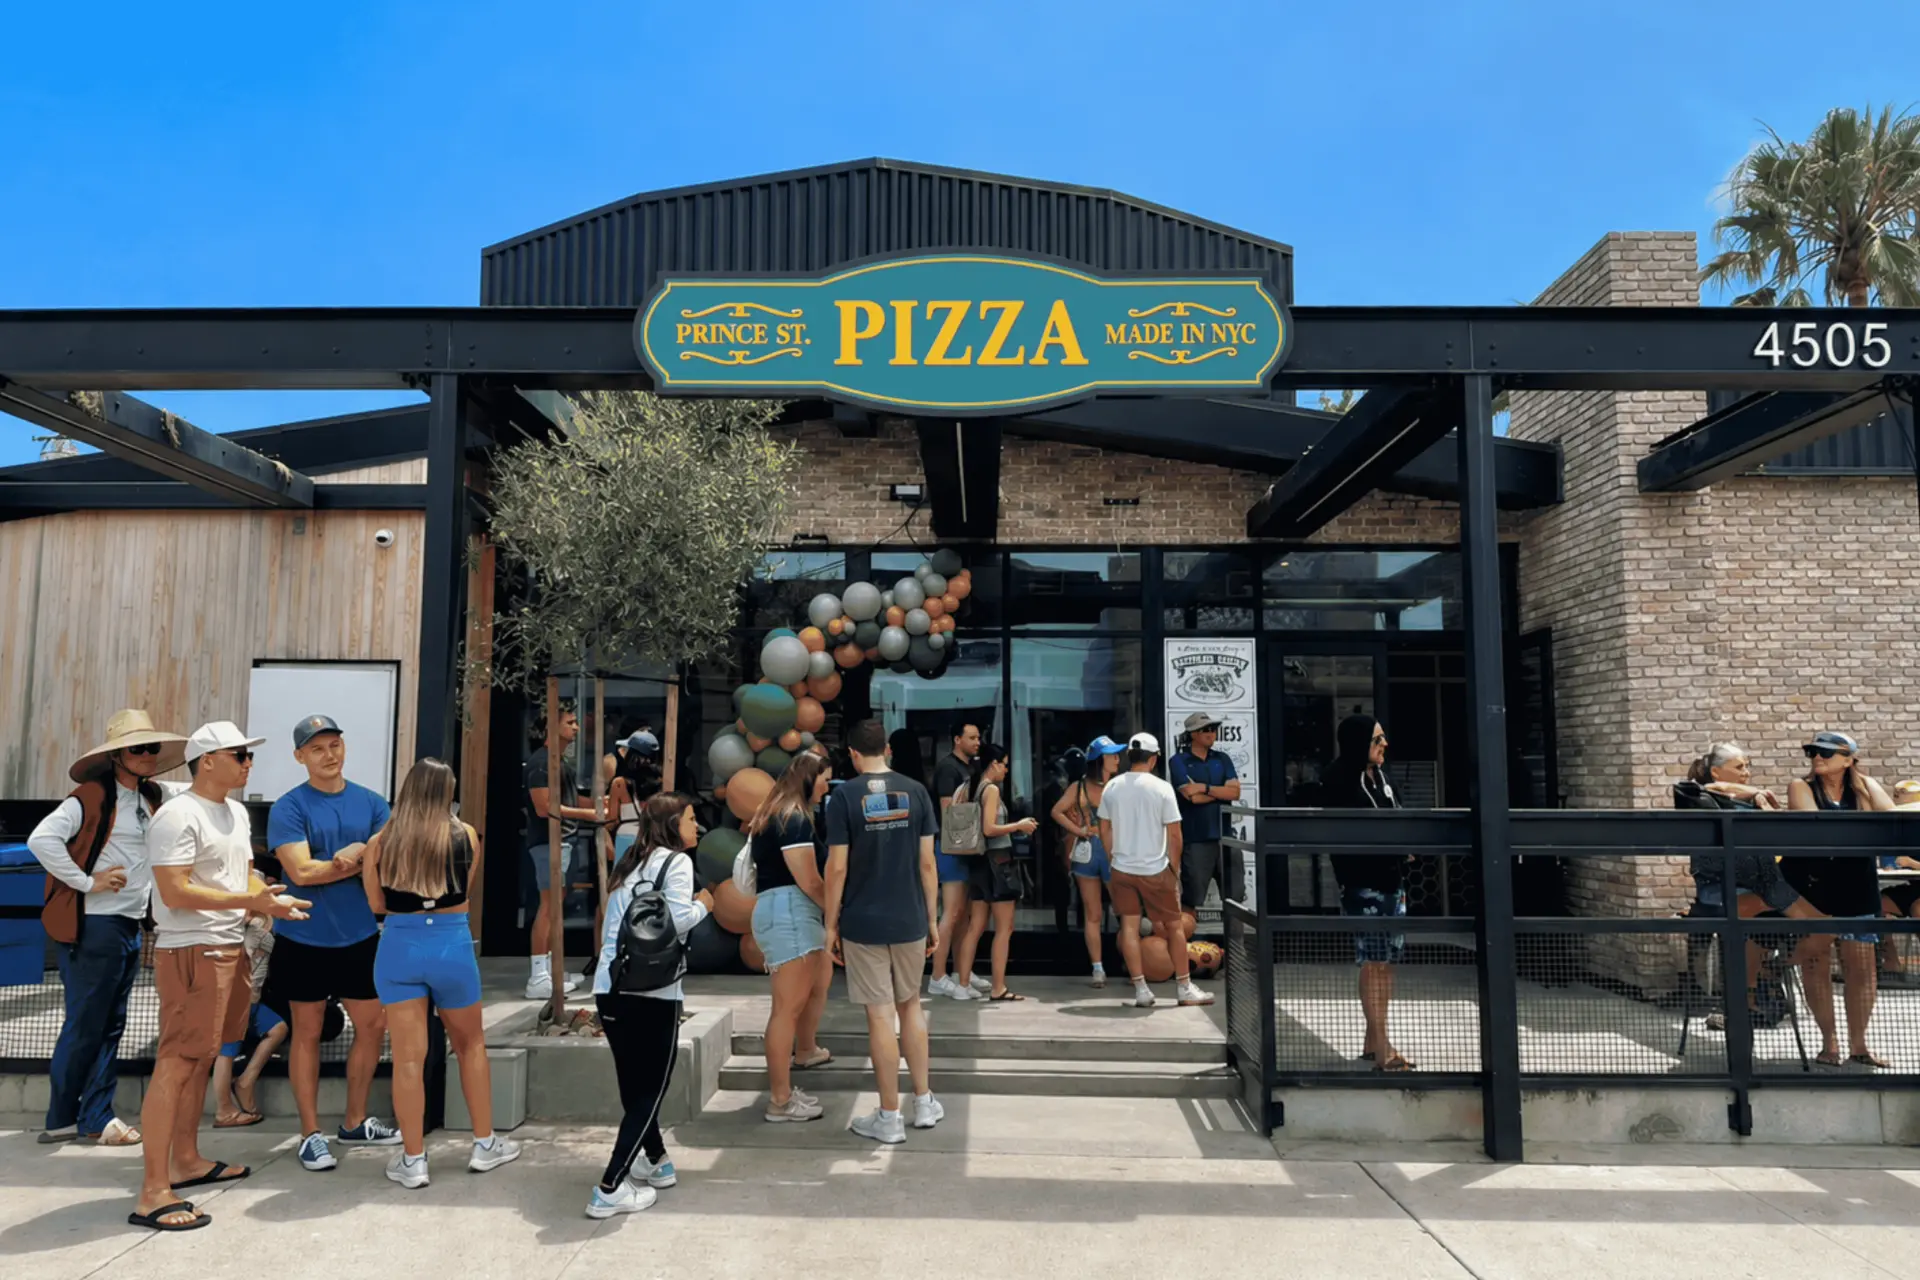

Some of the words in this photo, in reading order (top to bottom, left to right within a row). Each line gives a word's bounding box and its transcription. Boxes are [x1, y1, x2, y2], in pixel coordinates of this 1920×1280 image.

[677, 322, 768, 346] PRINCE
[777, 322, 812, 346] ST.
[833, 299, 1089, 367] PIZZA
[1104, 323, 1175, 346] MADE
[1181, 323, 1206, 346] IN
[1211, 323, 1257, 346] NYC
[1753, 321, 1892, 367] 4505
